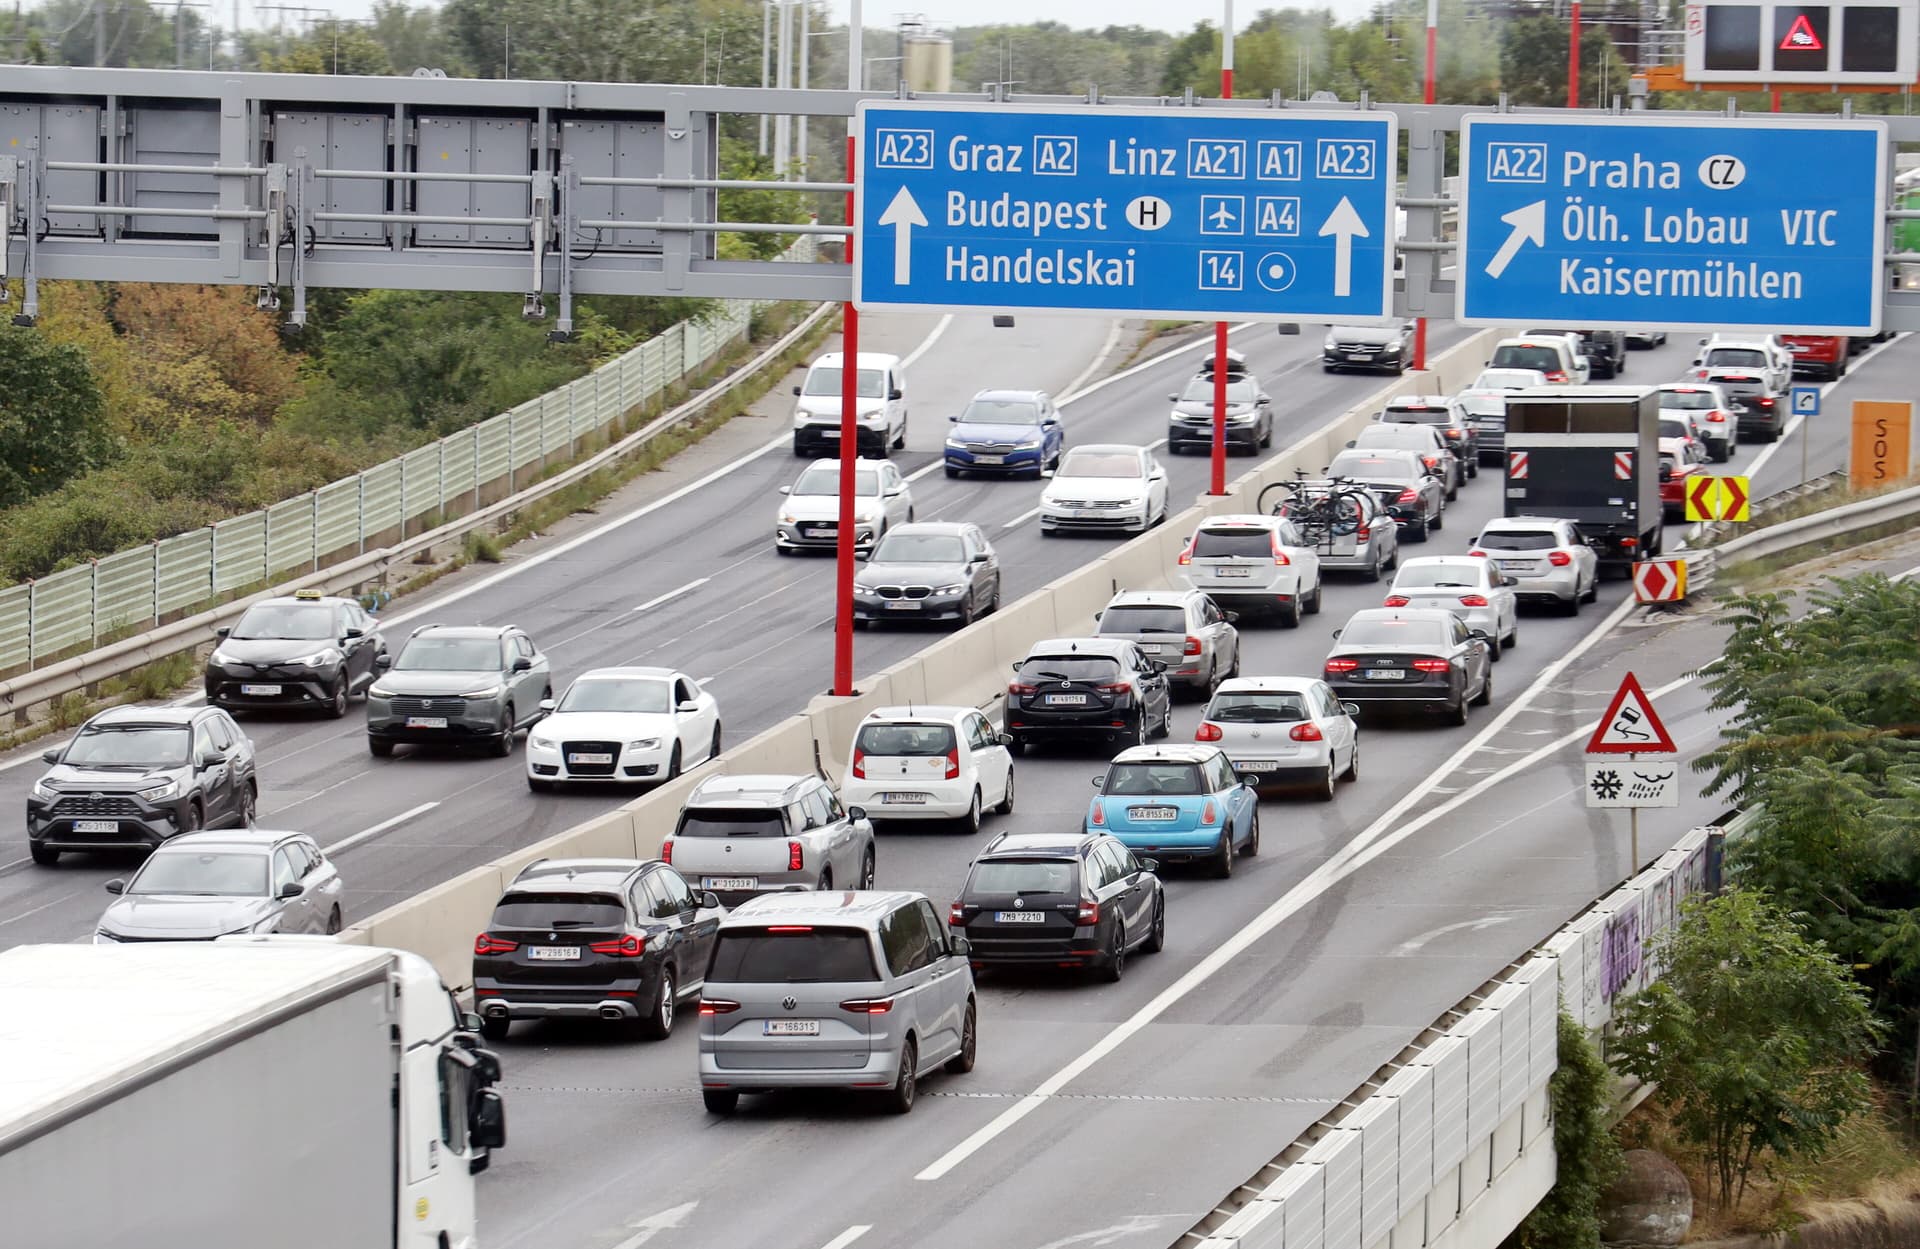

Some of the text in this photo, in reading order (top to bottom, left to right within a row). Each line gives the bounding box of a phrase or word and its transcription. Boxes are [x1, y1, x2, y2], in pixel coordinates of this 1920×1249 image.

[881, 132, 1371, 176] A23 Graz A2 Linz A21 A1 A23
[1492, 148, 1736, 190] A22 Praha CZ
[946, 190, 1295, 237] Budapest H A4
[1562, 197, 1838, 247] Ölh. Lobau VIC
[945, 246, 1236, 287] Handelskai 14
[1559, 257, 1802, 300] Kaisermühlen
[1873, 418, 1888, 480] SOS
[1001, 912, 1042, 921] 7M9 2210
